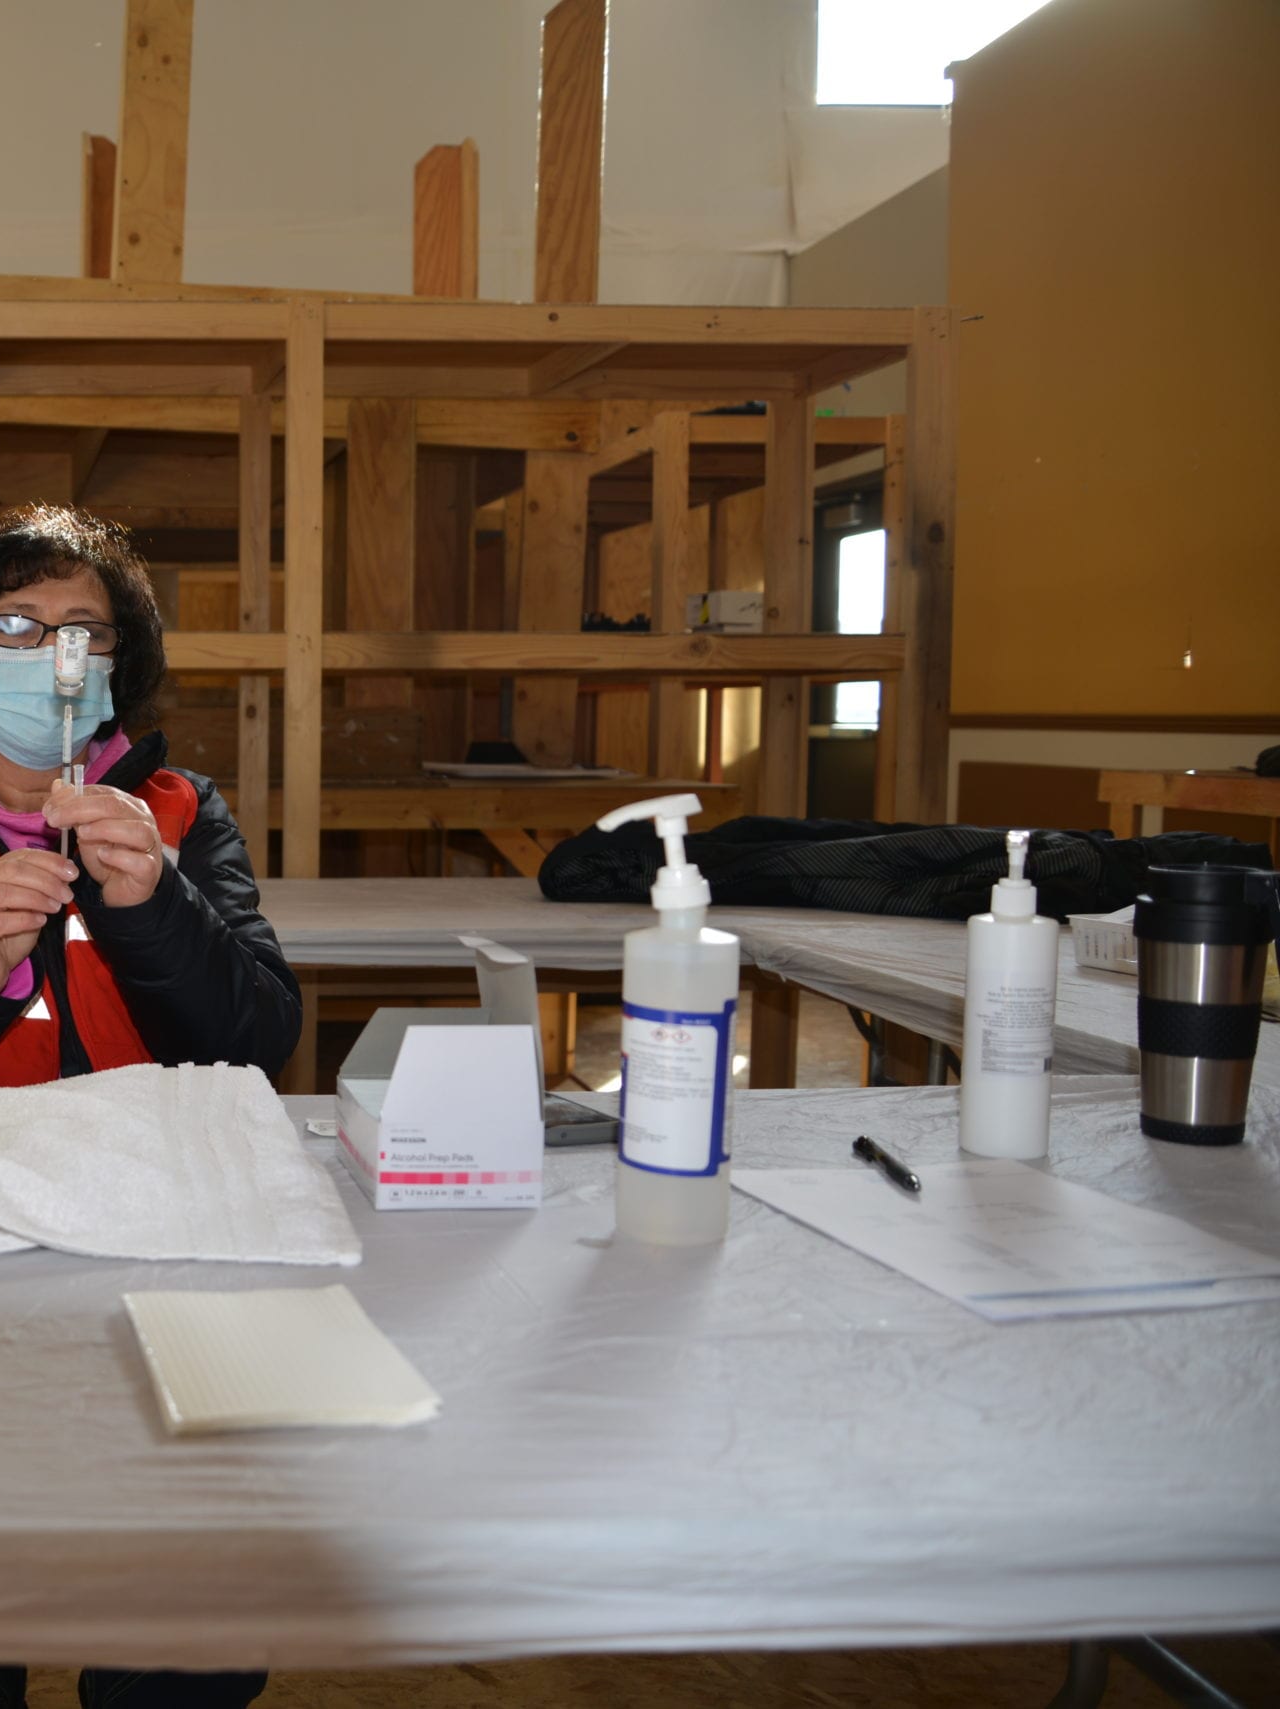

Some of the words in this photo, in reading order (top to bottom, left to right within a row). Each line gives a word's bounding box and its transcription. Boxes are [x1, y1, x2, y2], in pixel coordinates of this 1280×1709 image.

[391, 1153, 426, 1163] Alcohol
[428, 1153, 450, 1165] Prep
[452, 1152, 474, 1163] Pads
